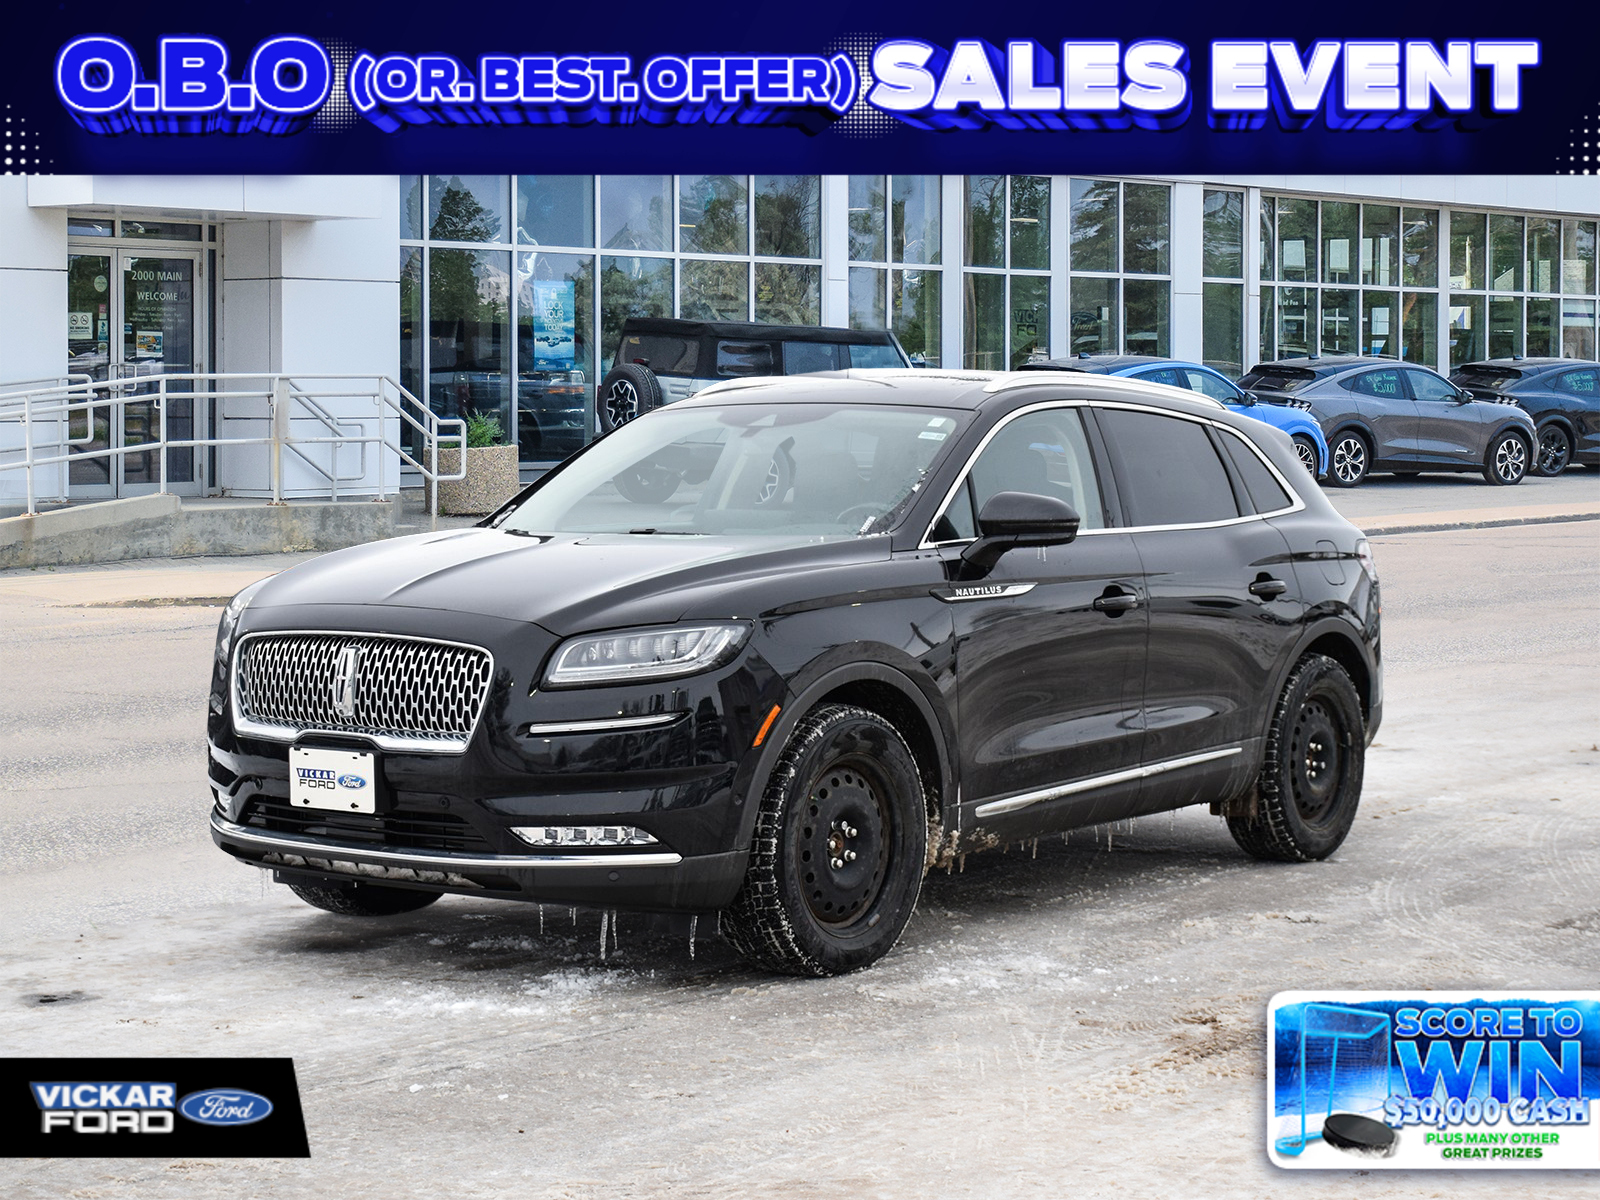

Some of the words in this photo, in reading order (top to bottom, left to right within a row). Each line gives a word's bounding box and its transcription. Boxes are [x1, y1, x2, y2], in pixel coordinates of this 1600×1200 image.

[131, 270, 155, 281] 2000
[157, 271, 183, 282] MAIN
[136, 291, 178, 301] WELCOME
[543, 300, 564, 310] LOCK
[543, 309, 564, 319] YOUR
[955, 586, 1002, 597] NAUTILUS
[297, 768, 335, 780] VICKAR
[299, 778, 336, 790] FORD
[341, 775, 361, 788] Ford
